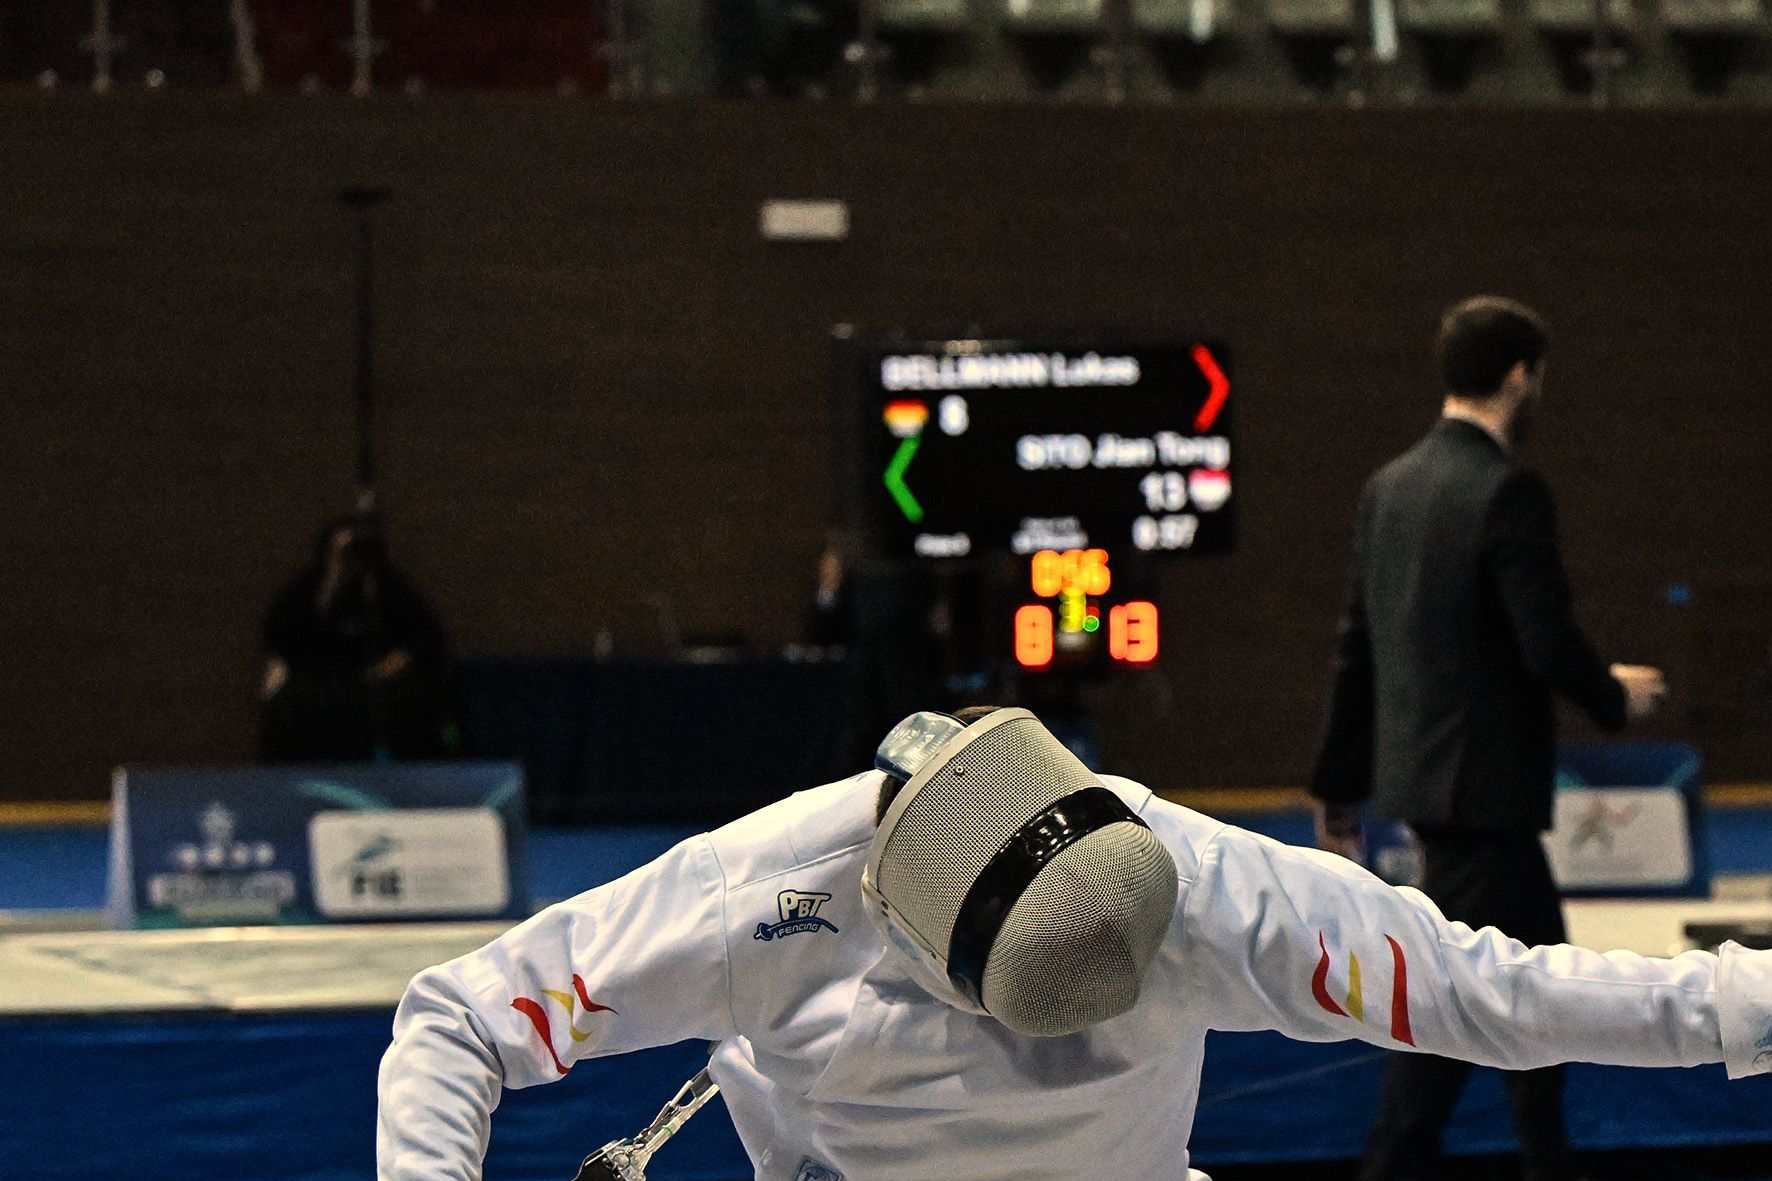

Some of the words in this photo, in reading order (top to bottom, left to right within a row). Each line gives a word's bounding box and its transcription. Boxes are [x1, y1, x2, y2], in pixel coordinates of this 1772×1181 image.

[1140, 472, 1187, 511] 13
[778, 890, 831, 920] PBT
[778, 922, 820, 938] FENCING
